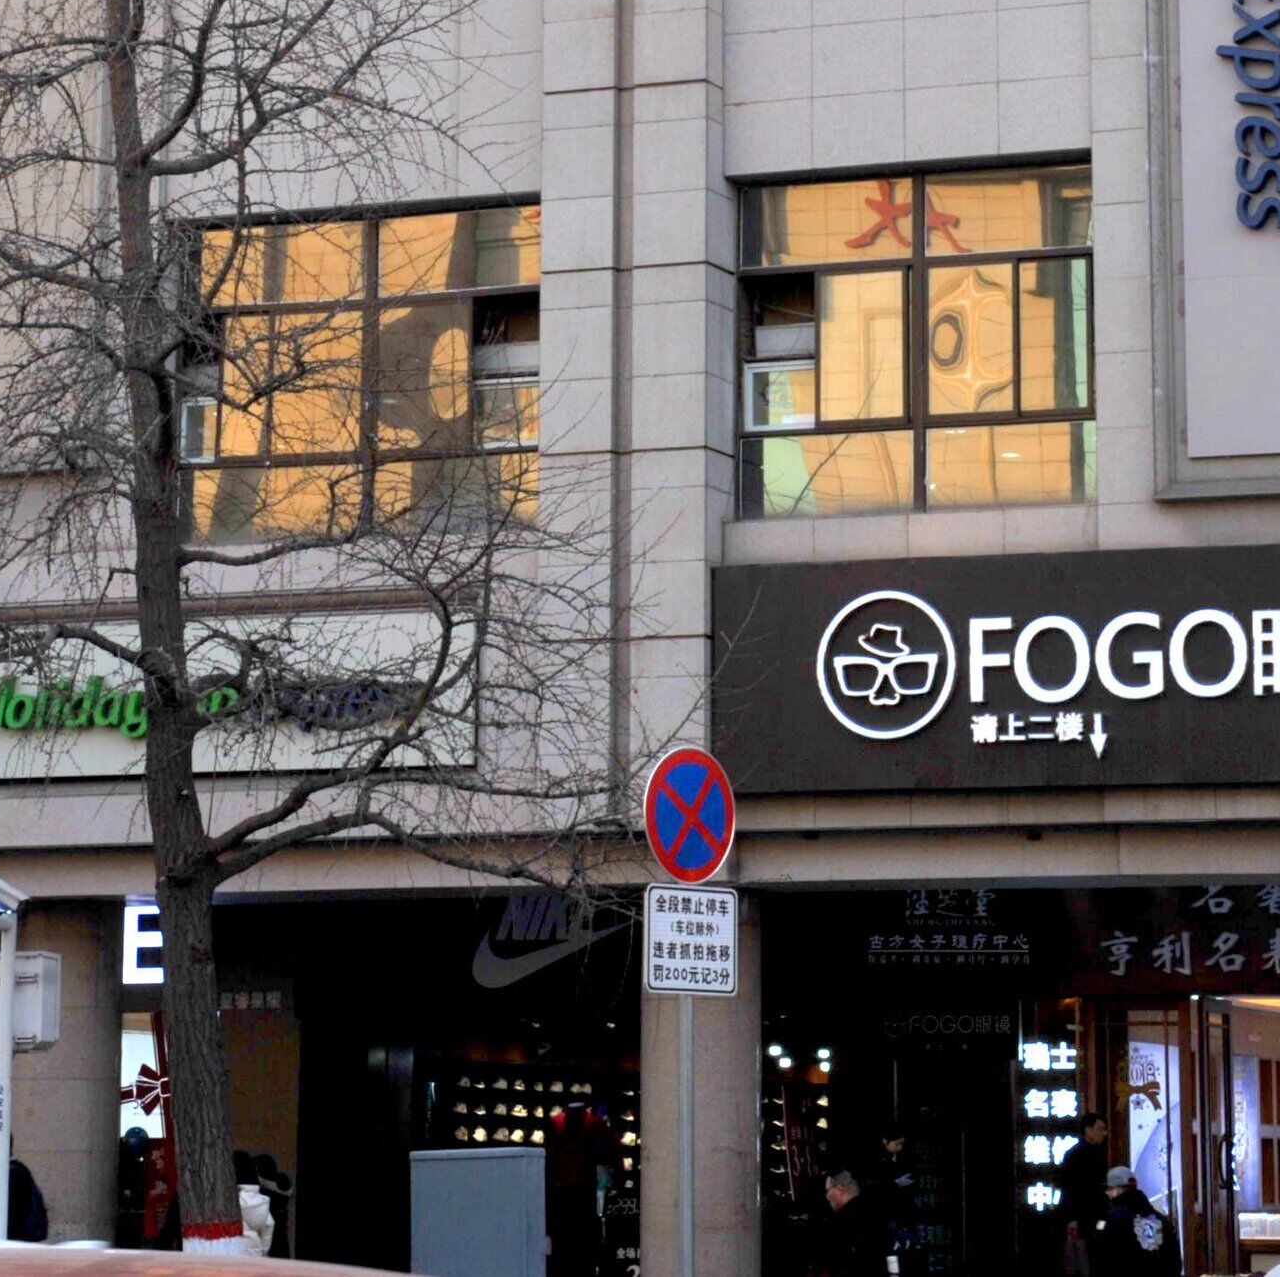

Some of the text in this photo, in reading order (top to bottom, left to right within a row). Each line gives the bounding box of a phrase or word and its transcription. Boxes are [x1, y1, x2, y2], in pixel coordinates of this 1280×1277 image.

[971, 712, 1085, 744] 请上二楼
[656, 894, 730, 918] 全段禁止停车
[652, 941, 731, 963] 违者抓拍拖移
[653, 964, 731, 986] 罚200元记3分
[1023, 1041, 1077, 1071] 瑞士
[1023, 1088, 1078, 1118] 名表
